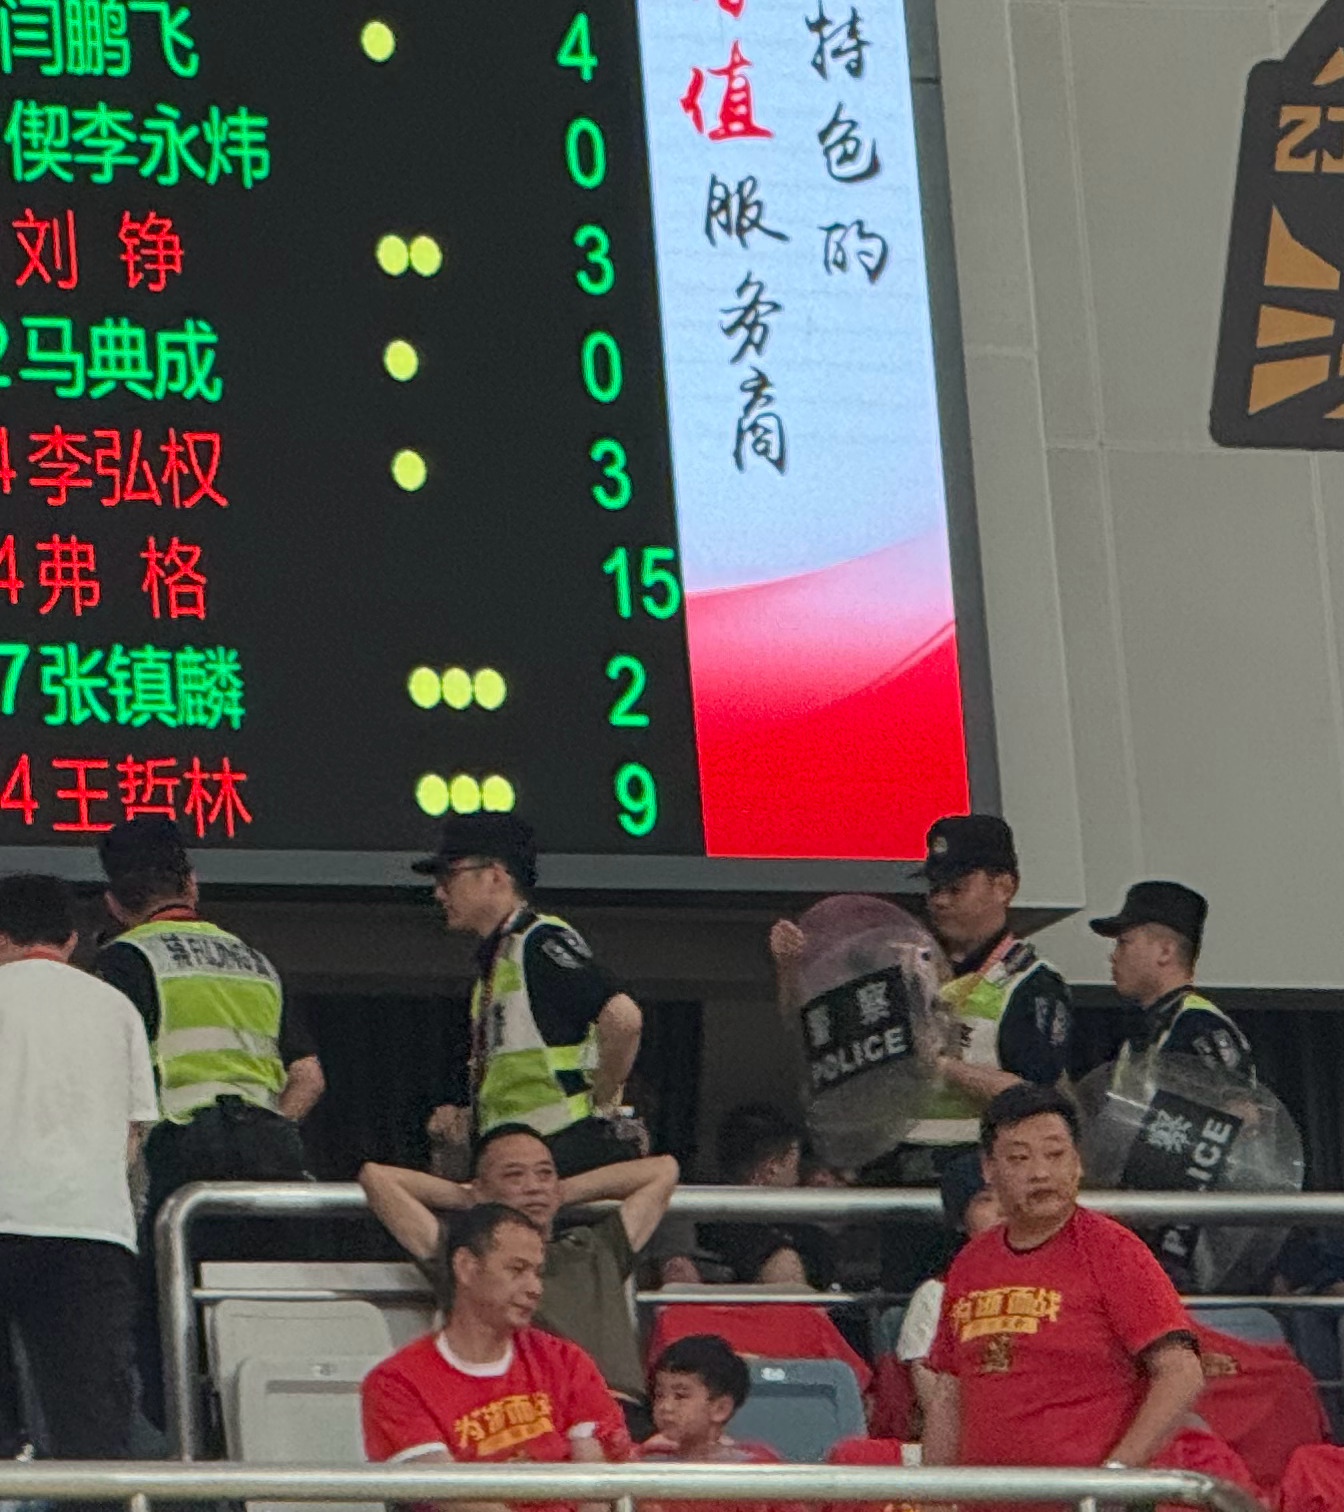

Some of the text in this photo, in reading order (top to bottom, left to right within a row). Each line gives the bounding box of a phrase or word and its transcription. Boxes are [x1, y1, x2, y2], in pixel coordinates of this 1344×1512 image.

[557, 13, 597, 81] 4
[567, 118, 606, 188] 0
[574, 225, 614, 294] 3
[583, 332, 622, 402] 0
[591, 440, 631, 509] 3
[603, 547, 679, 619] 15
[607, 656, 649, 726] 2
[616, 764, 657, 836] 9
